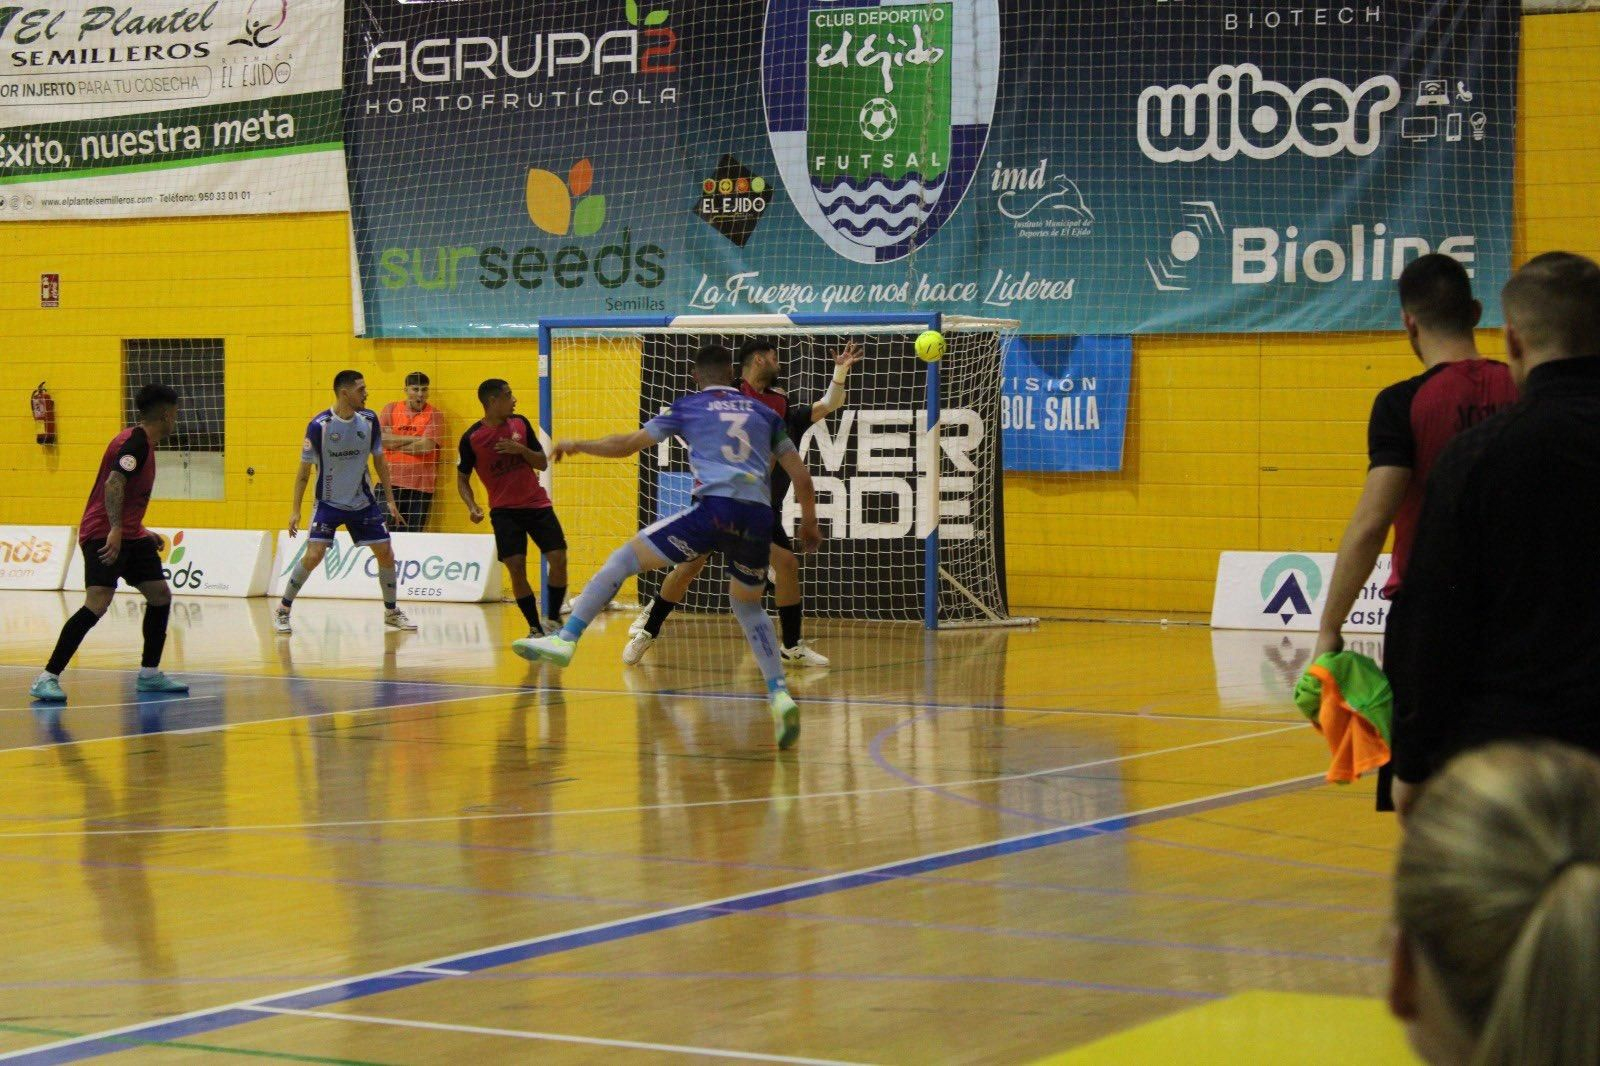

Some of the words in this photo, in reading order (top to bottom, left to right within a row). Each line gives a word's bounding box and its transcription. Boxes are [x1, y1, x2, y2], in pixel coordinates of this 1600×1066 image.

[14, 8, 65, 45] El
[78, 1, 219, 42] Plantel
[816, 13, 854, 27] CLUB
[858, 8, 945, 25] DEPORTIVO
[1225, 6, 1381, 30] BIOTECH
[11, 41, 211, 67] SEMILLEROS
[22, 82, 76, 97] INJERTO
[78, 78, 115, 95] PARA
[116, 77, 132, 94] TU
[132, 74, 200, 93] COSECHA
[366, 87, 677, 115] HORTOFRUTÍCOLA
[1137, 63, 1400, 163] wiber
[81, 122, 201, 161] nuestra
[213, 109, 294, 147] meta
[816, 152, 941, 171] FUTSAL
[991, 158, 1048, 191] imd
[198, 192, 215, 201] 950
[216, 192, 226, 201] 33
[228, 191, 238, 200] 01
[241, 191, 251, 200] 01
[703, 199, 719, 213] EL
[723, 197, 766, 213] EJIDO
[605, 297, 665, 311] Semillas
[688, 274, 725, 309] La
[725, 271, 817, 315] Fuerza
[823, 283, 867, 312] que
[869, 280, 908, 302] nos
[915, 274, 978, 307] hace
[983, 269, 1076, 307] Líderes
[1044, 395, 1100, 431] SALA
[719, 413, 751, 463] 3
[364, 555, 481, 585] CpGen
[408, 587, 442, 597] SEEDS
